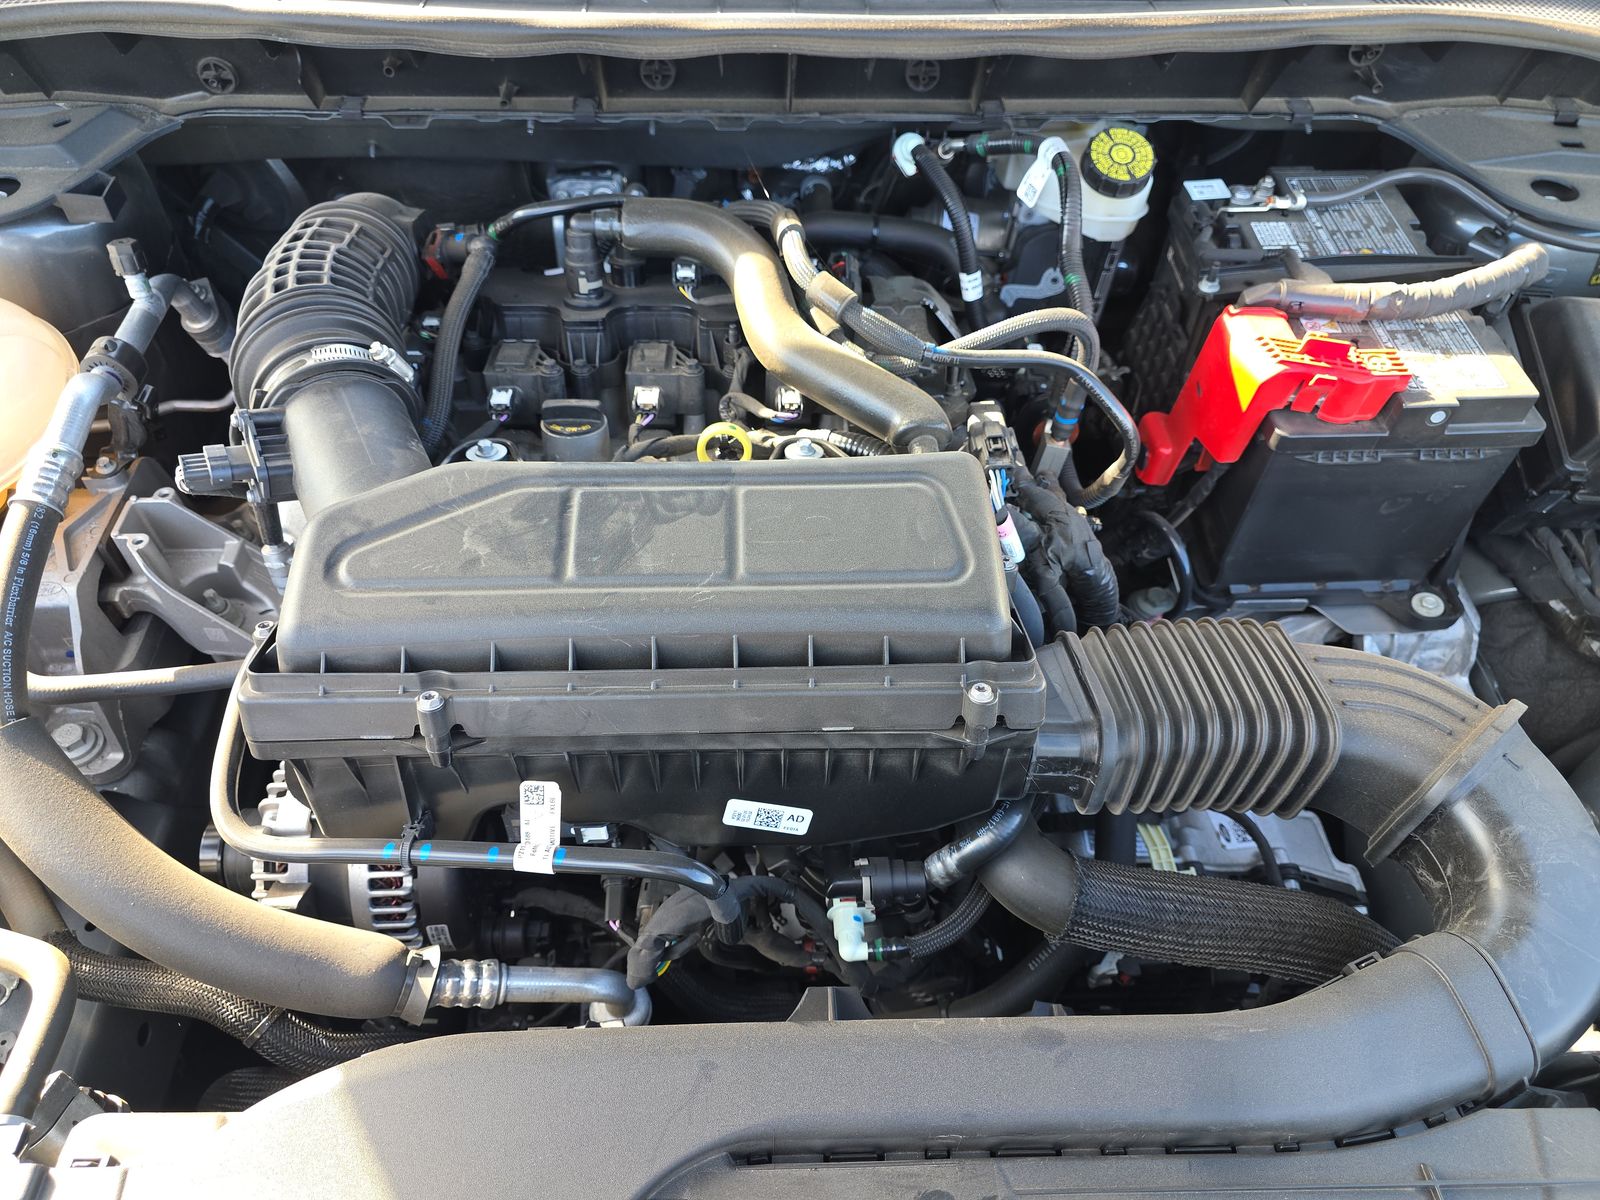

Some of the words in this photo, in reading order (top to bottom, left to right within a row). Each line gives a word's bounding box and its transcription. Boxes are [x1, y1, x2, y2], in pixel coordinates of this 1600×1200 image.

[22, 521, 40, 551] (16mm)
[19, 551, 30, 566] 5/8
[5, 575, 24, 627] Flexbarrier
[3, 630, 13, 646] A/C
[3, 648, 12, 689] SUCTION
[4, 691, 15, 716] HOSE
[787, 814, 805, 823] AD
